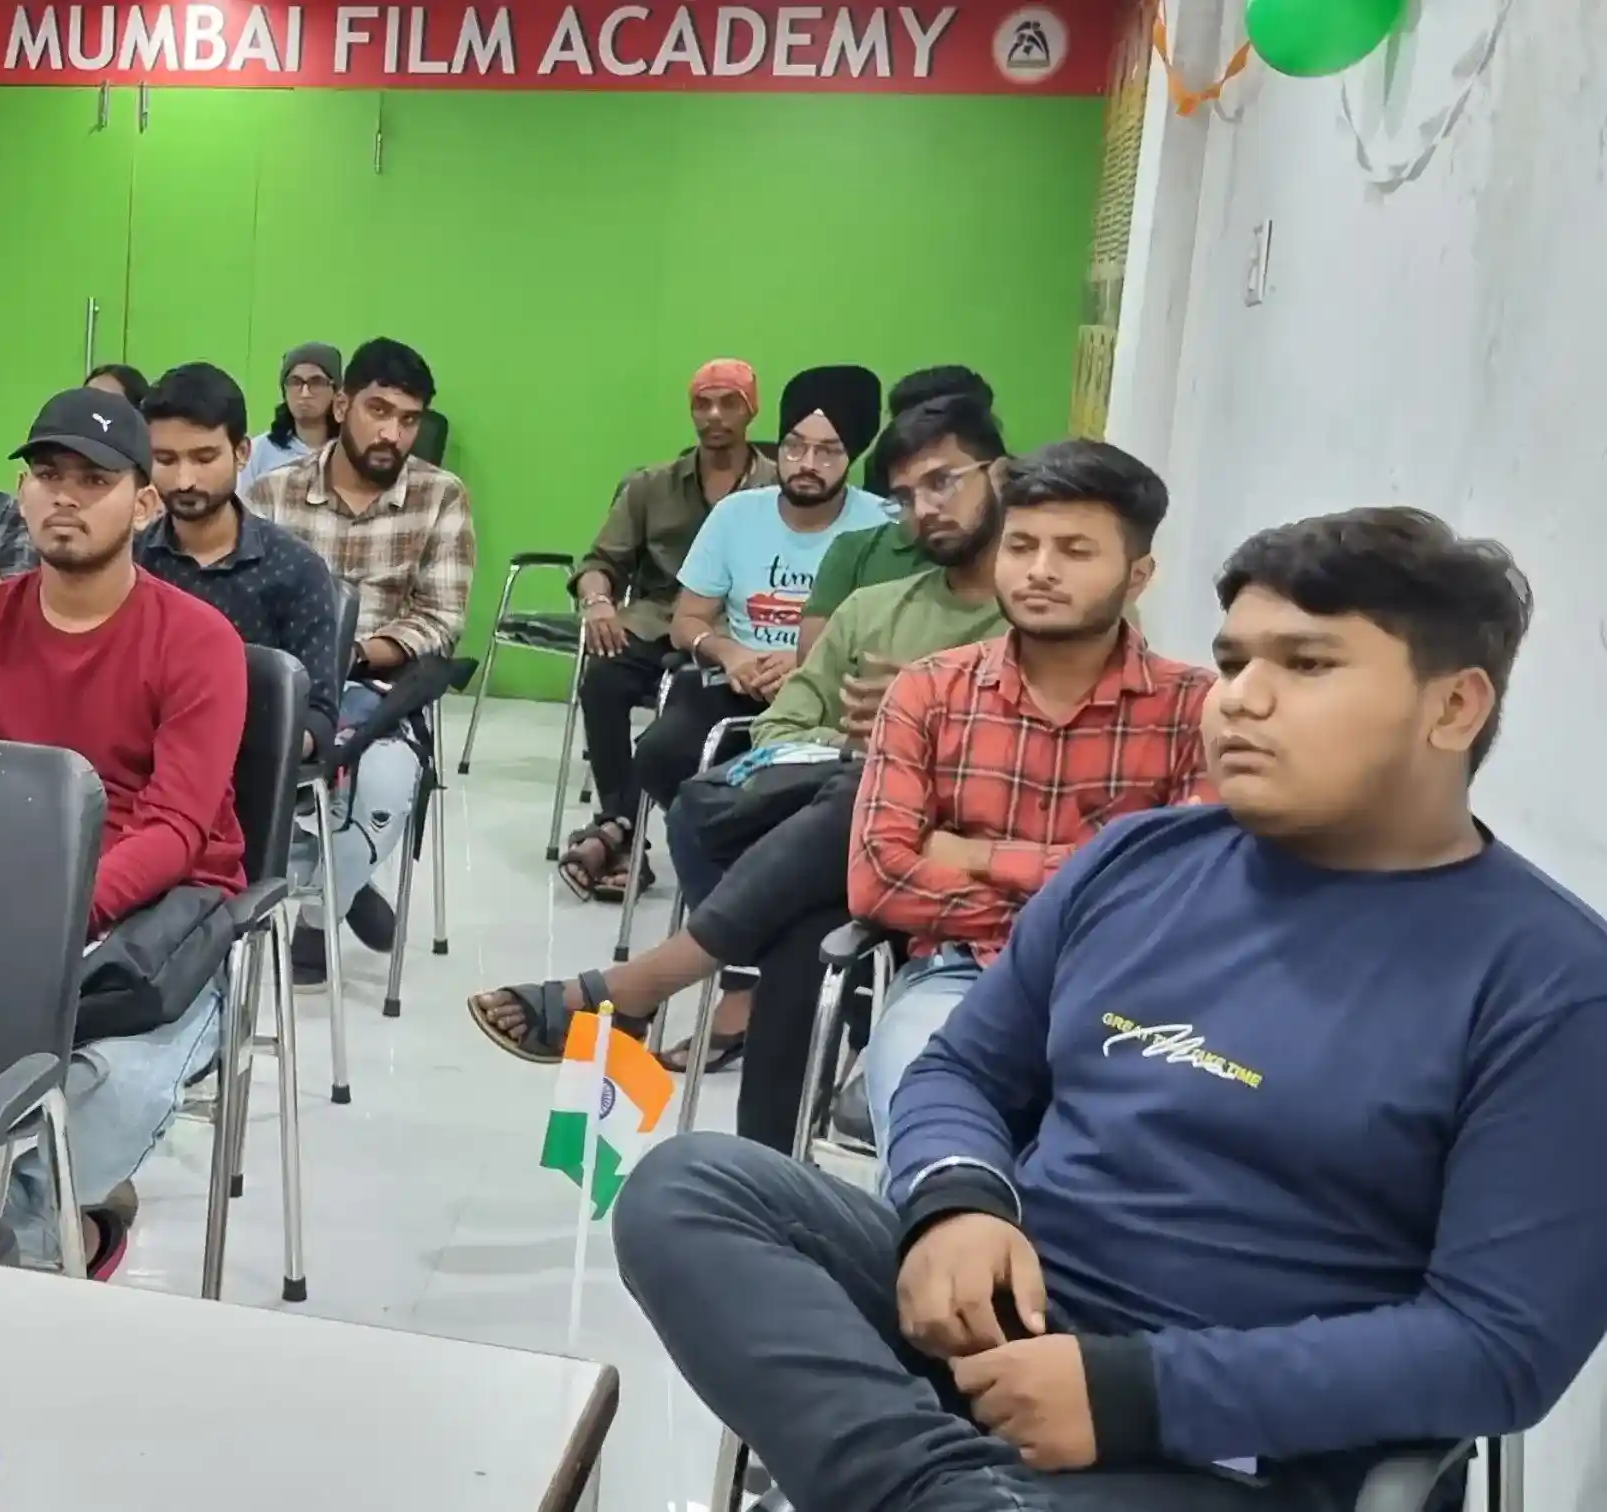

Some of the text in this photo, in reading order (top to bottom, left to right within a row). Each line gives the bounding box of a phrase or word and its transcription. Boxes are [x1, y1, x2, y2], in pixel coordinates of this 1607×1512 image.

[3, 5, 957, 77] MUMBAI FILM ACADEMY
